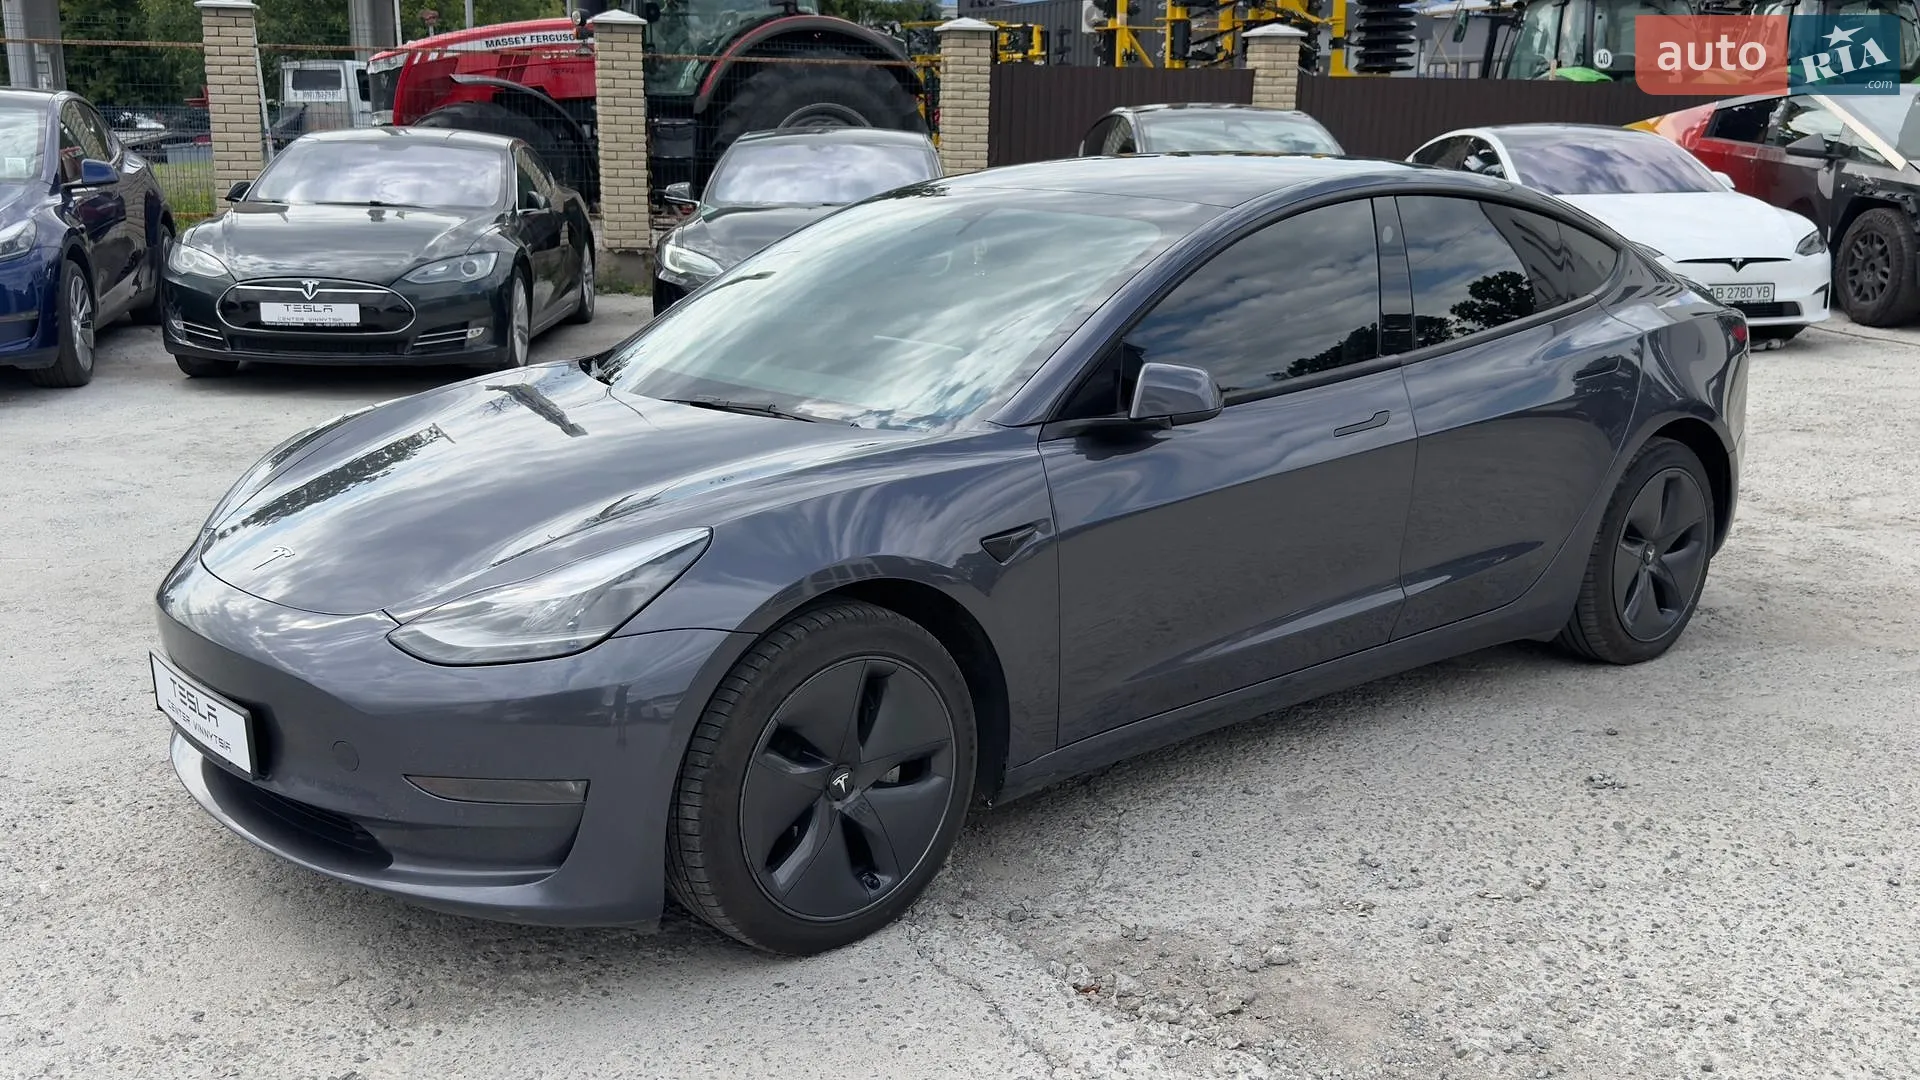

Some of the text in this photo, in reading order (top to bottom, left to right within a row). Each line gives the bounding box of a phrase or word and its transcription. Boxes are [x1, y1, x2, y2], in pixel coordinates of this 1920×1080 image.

[484, 33, 576, 49] MASSEY FERGUSO
[1598, 52, 1609, 65] 40
[1727, 286, 1753, 299] 2780
[1756, 286, 1770, 298] YB
[283, 304, 333, 313] TESLA
[169, 676, 219, 728] TESLA
[167, 699, 191, 725] CENTER
